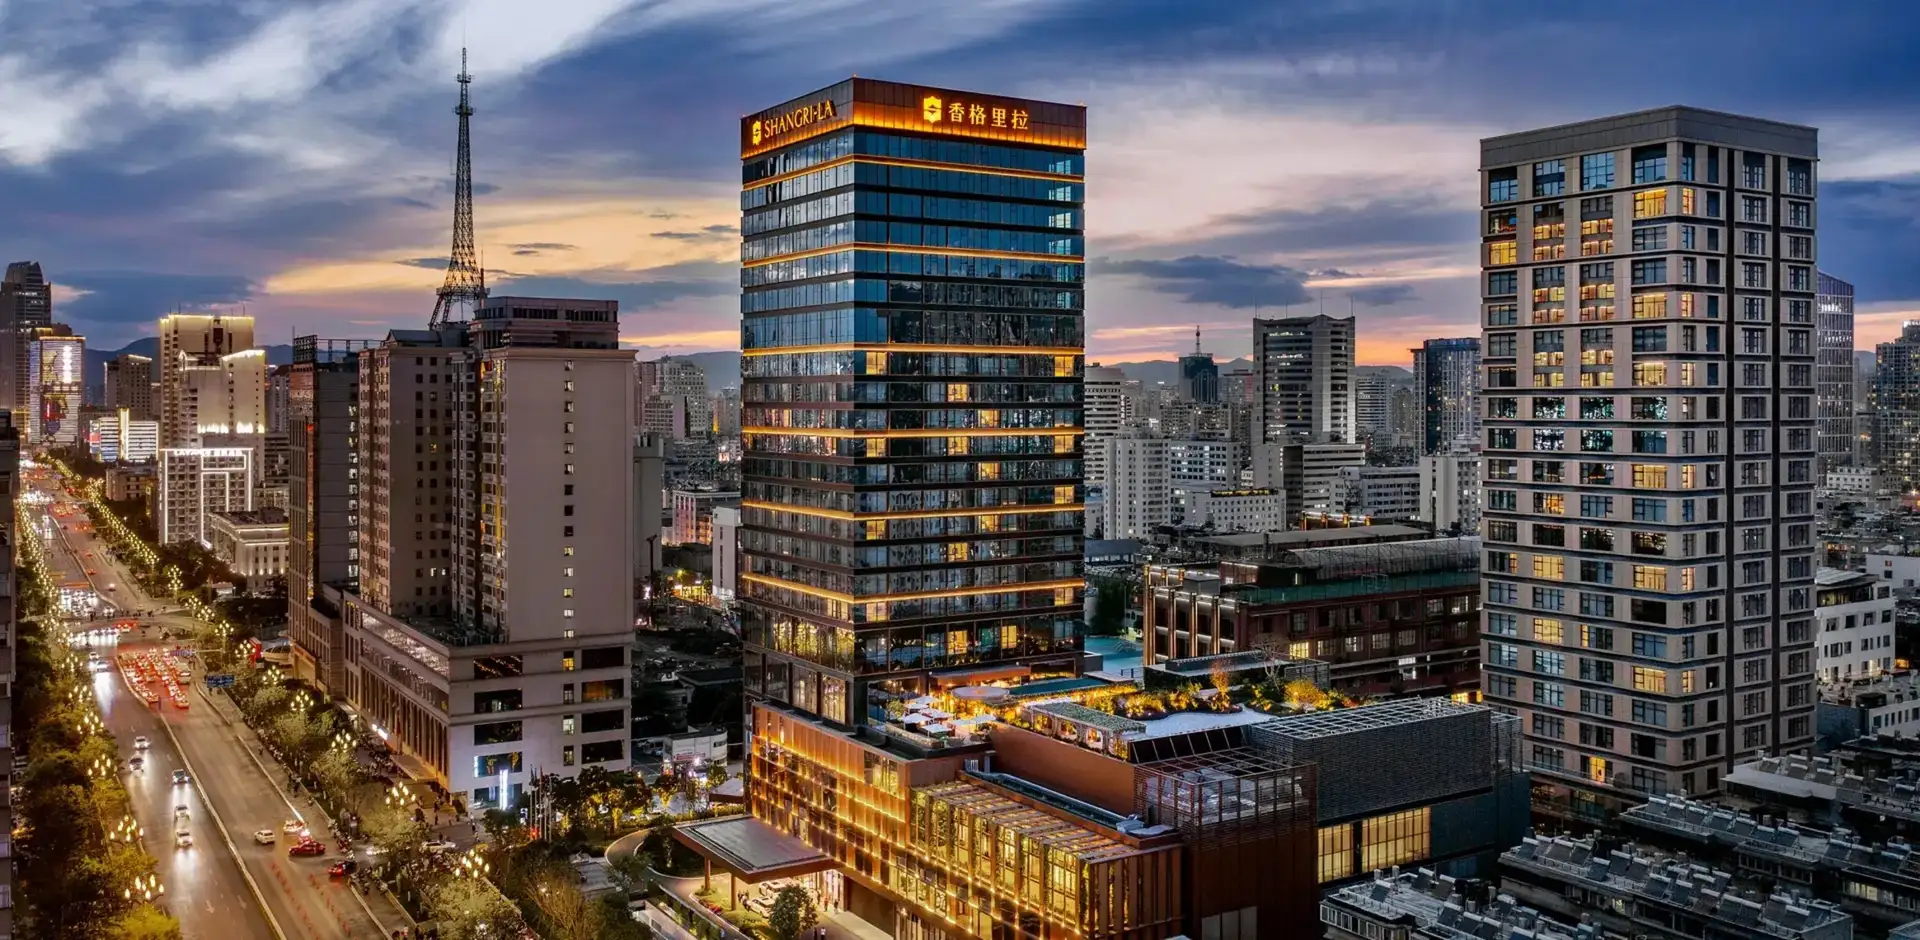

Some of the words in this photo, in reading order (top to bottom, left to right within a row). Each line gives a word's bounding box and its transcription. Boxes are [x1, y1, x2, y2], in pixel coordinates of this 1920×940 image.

[764, 99, 834, 138] SHANGRI-LA
[948, 102, 1029, 130] 香格里拉
